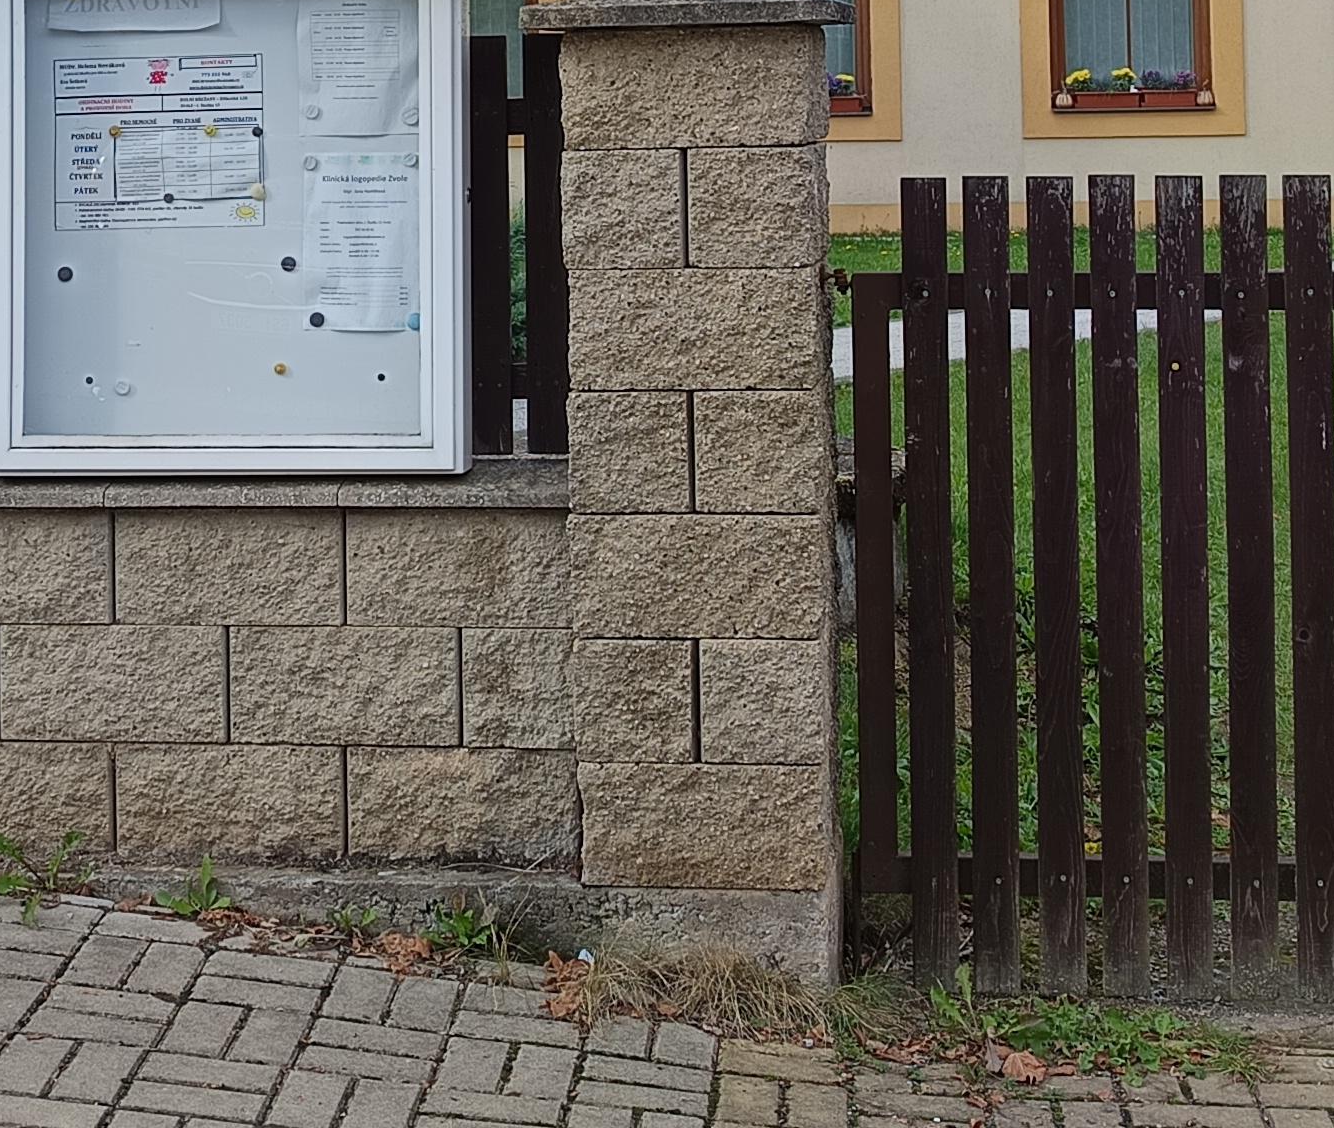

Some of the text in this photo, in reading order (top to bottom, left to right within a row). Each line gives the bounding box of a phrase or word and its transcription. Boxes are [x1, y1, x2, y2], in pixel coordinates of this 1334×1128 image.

[71, 131, 102, 140] PONDĚLÍ
[71, 157, 100, 166] STŘEDA
[69, 172, 104, 180] ČTVRTEK
[322, 175, 350, 183] Klinická
[74, 186, 99, 195] PÁTEK
